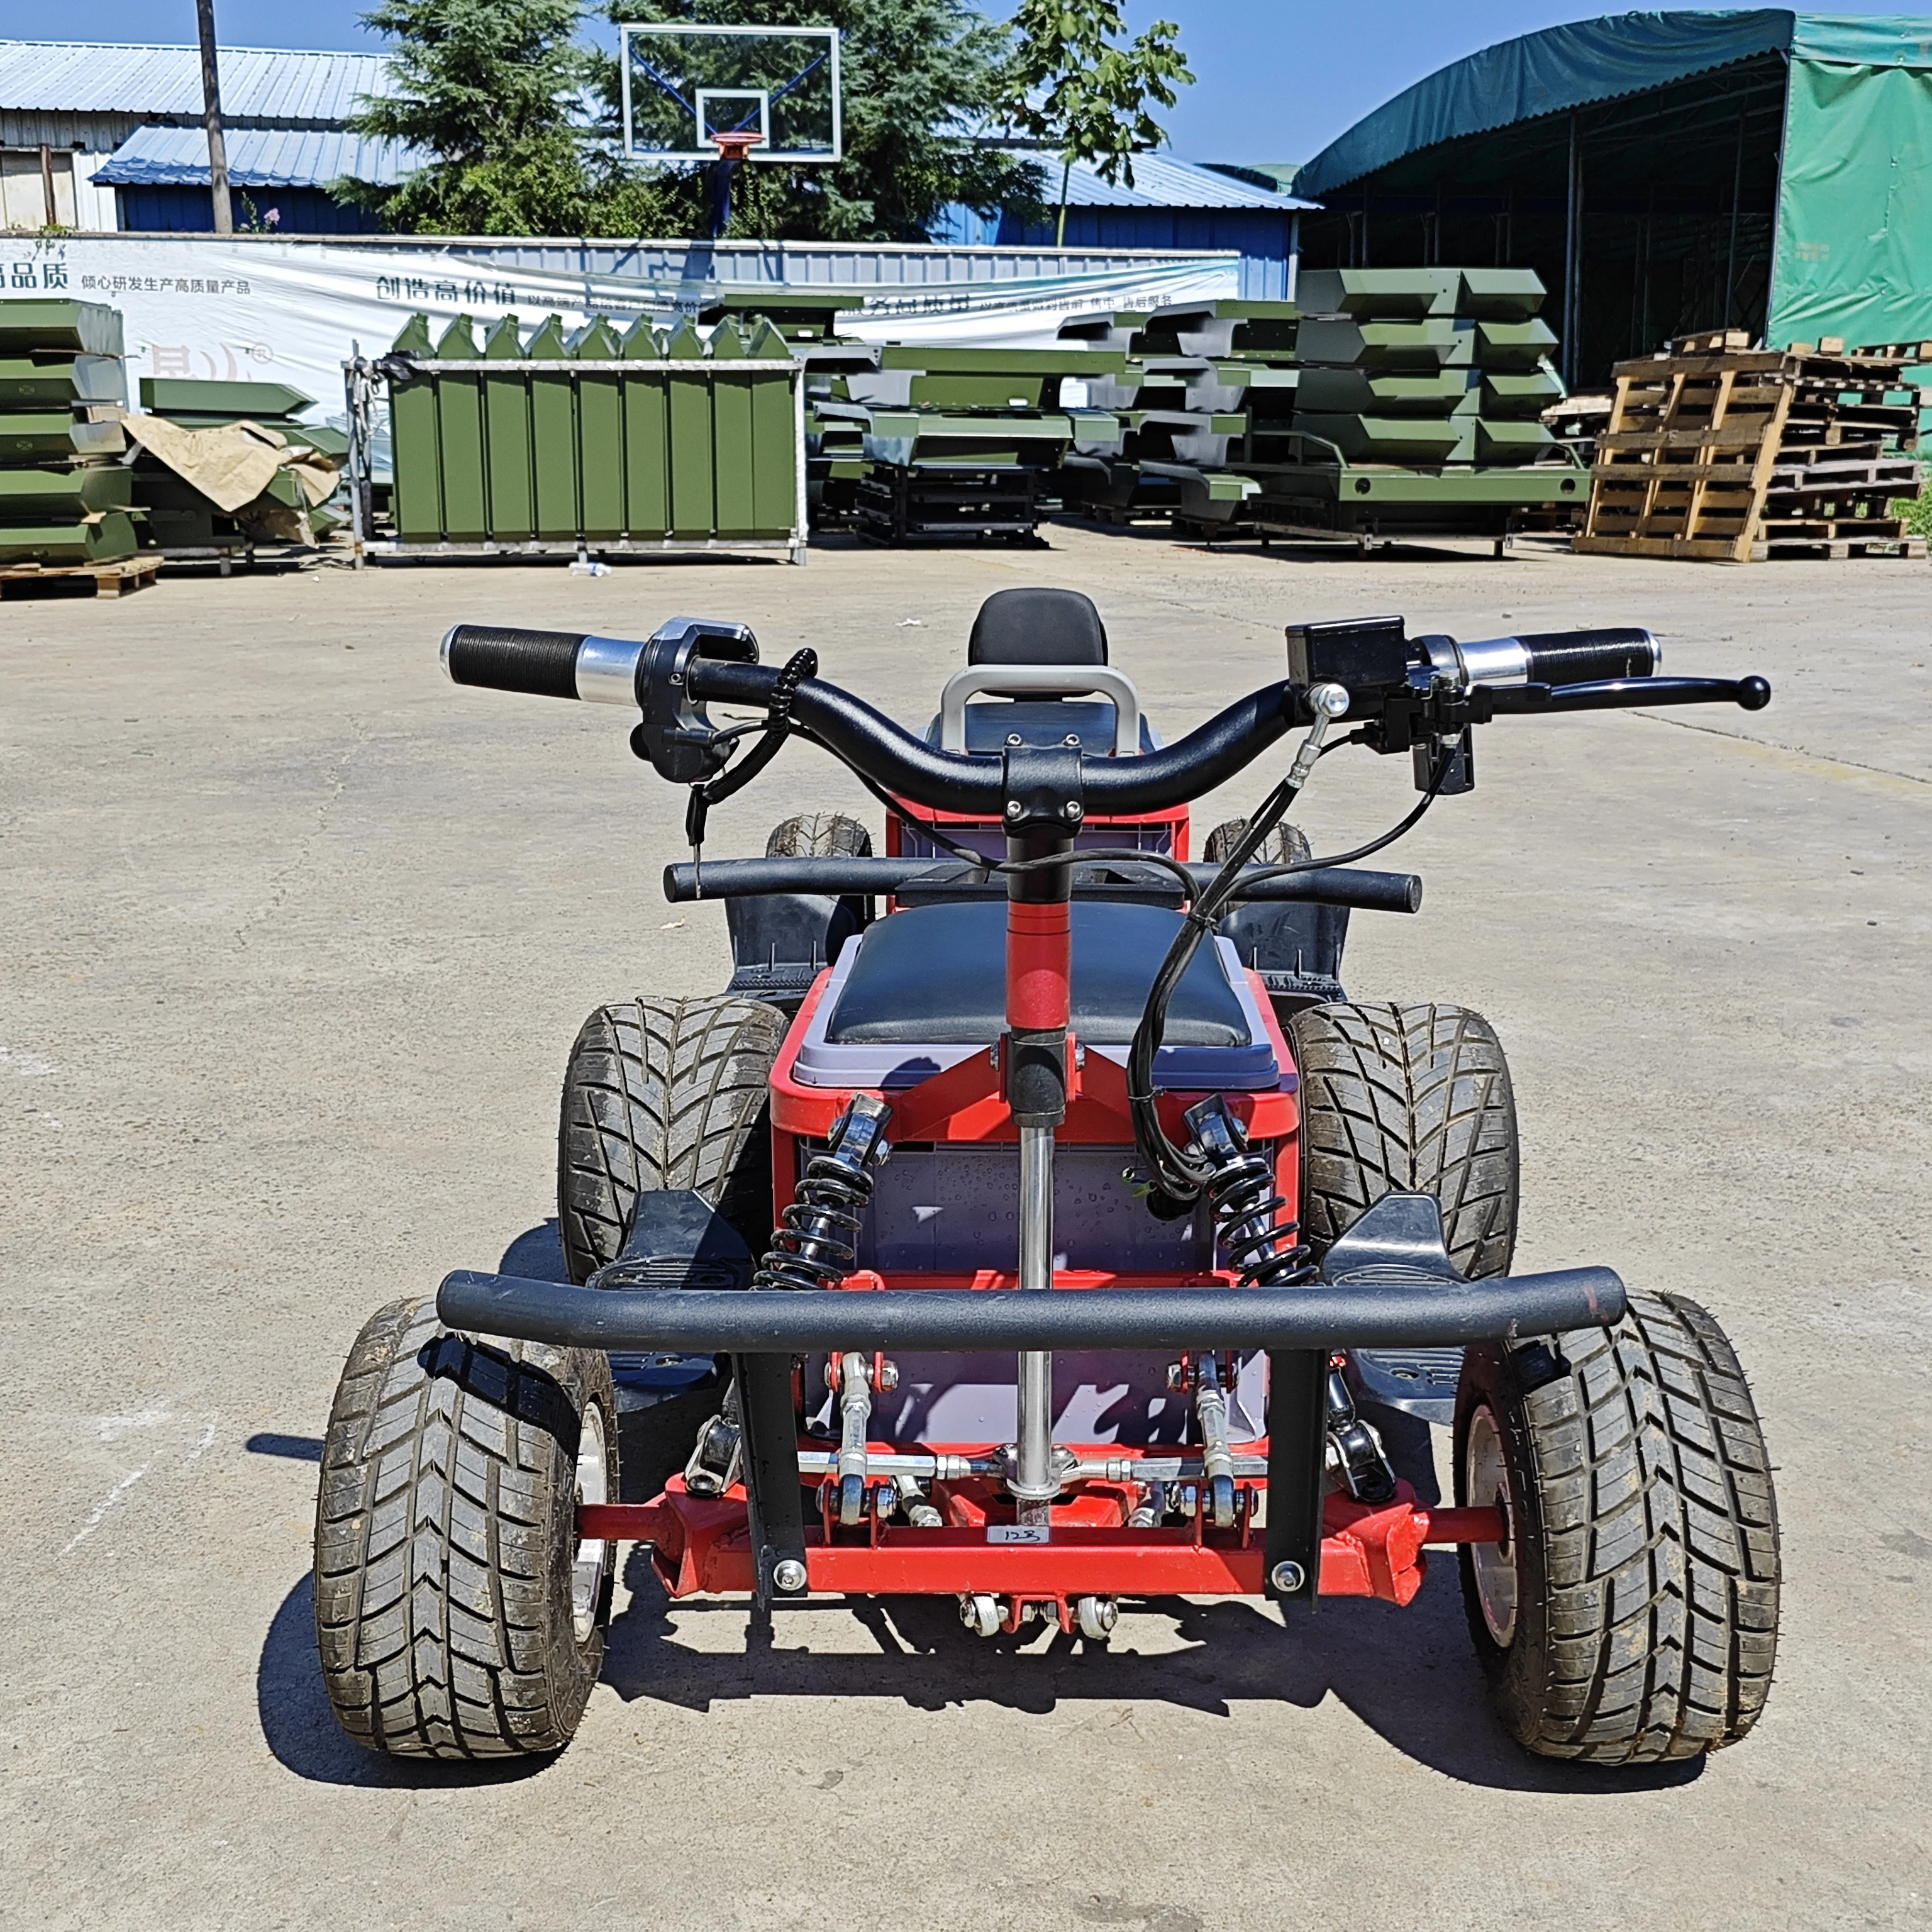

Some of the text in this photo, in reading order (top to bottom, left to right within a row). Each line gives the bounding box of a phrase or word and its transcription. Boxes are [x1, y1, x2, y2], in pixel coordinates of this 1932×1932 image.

[0, 262, 68, 289] 品质
[81, 274, 251, 295] 倾心研发生产高质量产品
[376, 275, 516, 306] 创造高价值
